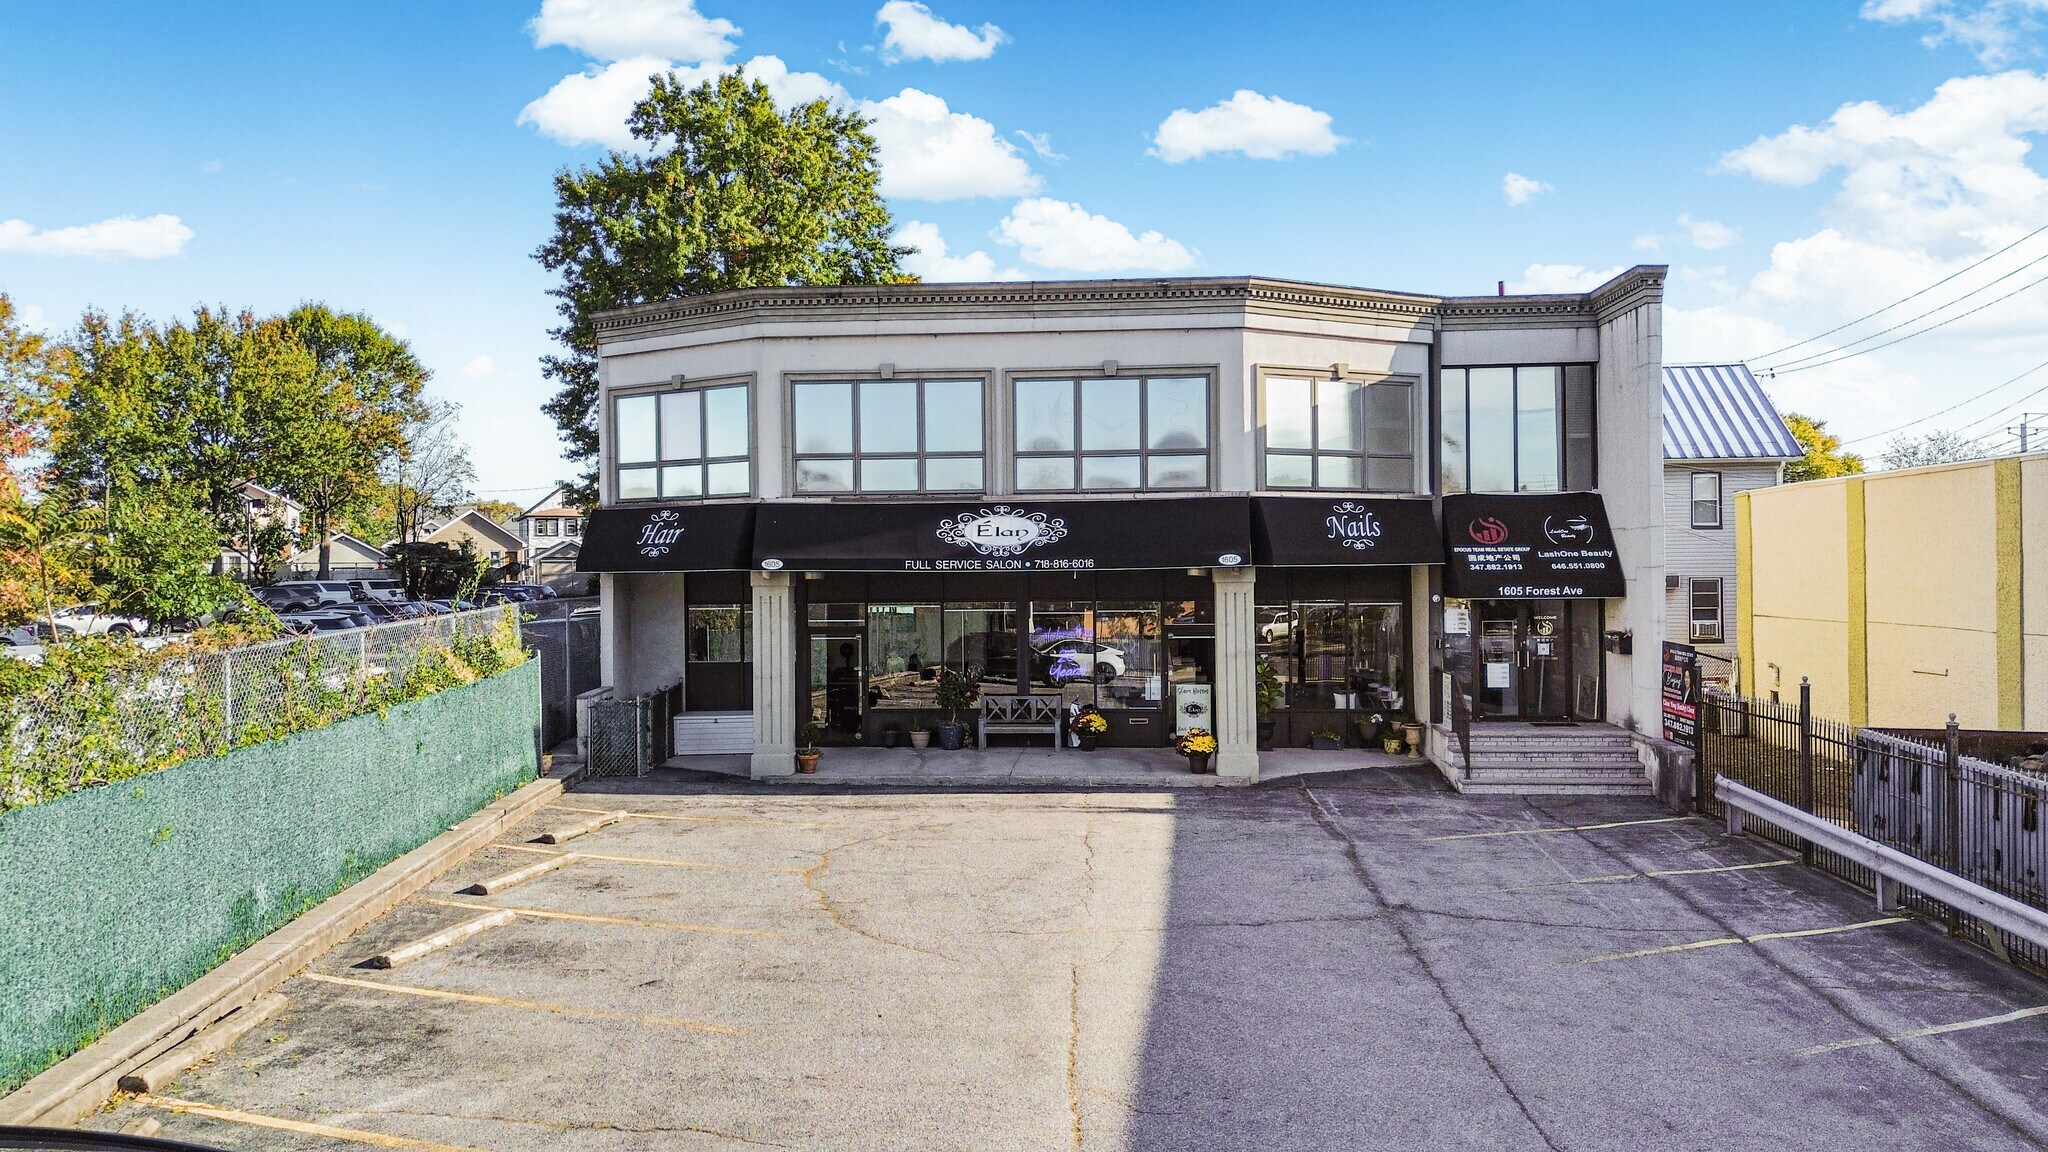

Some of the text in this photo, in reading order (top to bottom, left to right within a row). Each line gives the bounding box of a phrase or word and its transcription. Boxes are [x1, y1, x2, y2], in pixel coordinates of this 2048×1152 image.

[977, 520, 1029, 541] Élan
[1326, 512, 1381, 539] Nails
[636, 522, 685, 545] Hair
[1220, 556, 1239, 564] 1605
[1580, 550, 1613, 558] Beauty
[905, 558, 1095, 570] FULL SERVICE SALON 718-816-6016
[1498, 586, 1583, 596] 1605 Forest Ave
